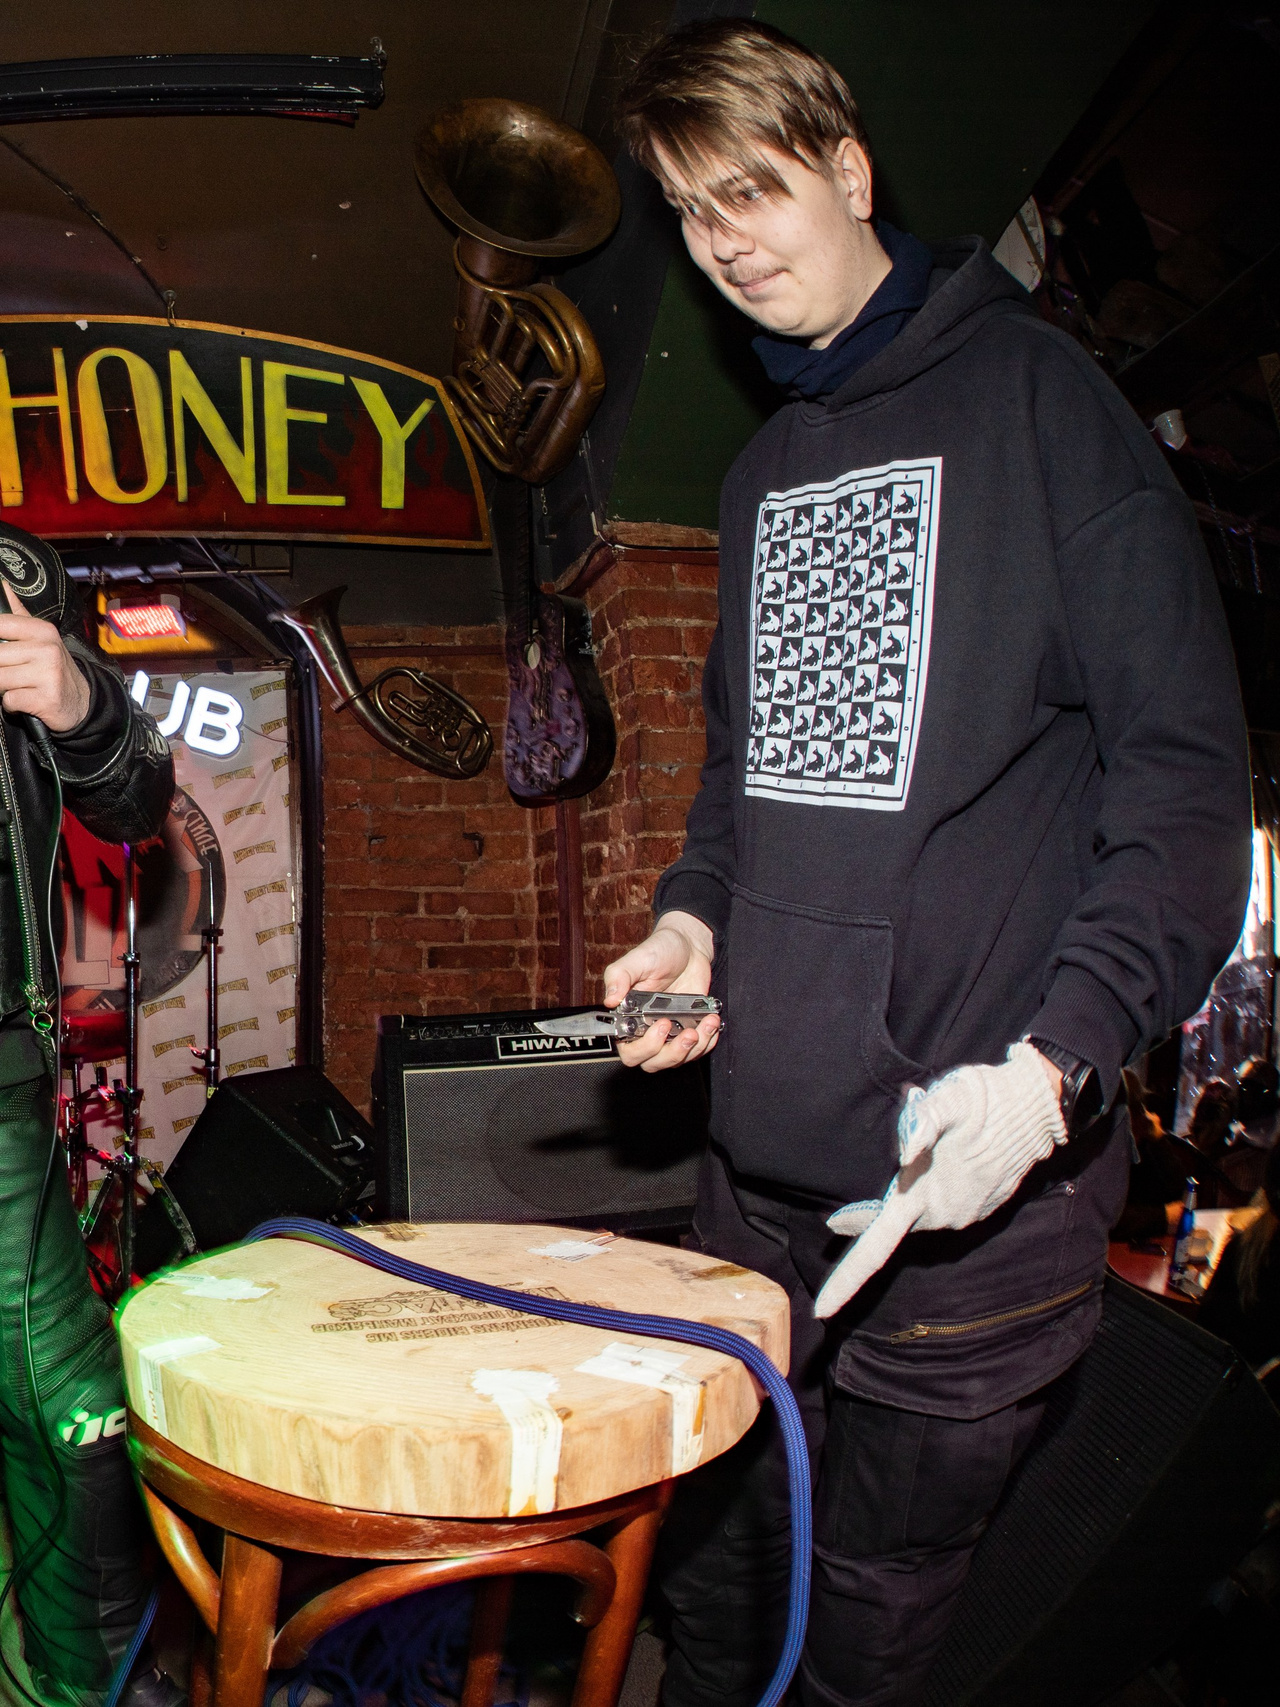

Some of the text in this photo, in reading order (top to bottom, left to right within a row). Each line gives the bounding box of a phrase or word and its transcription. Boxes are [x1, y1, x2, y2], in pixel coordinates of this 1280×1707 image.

[184, 809, 219, 857] СТИЛЕ
[511, 1035, 596, 1052] HIWATT
[366, 1332, 398, 1343] MC
[400, 1326, 470, 1340] RIDERS
